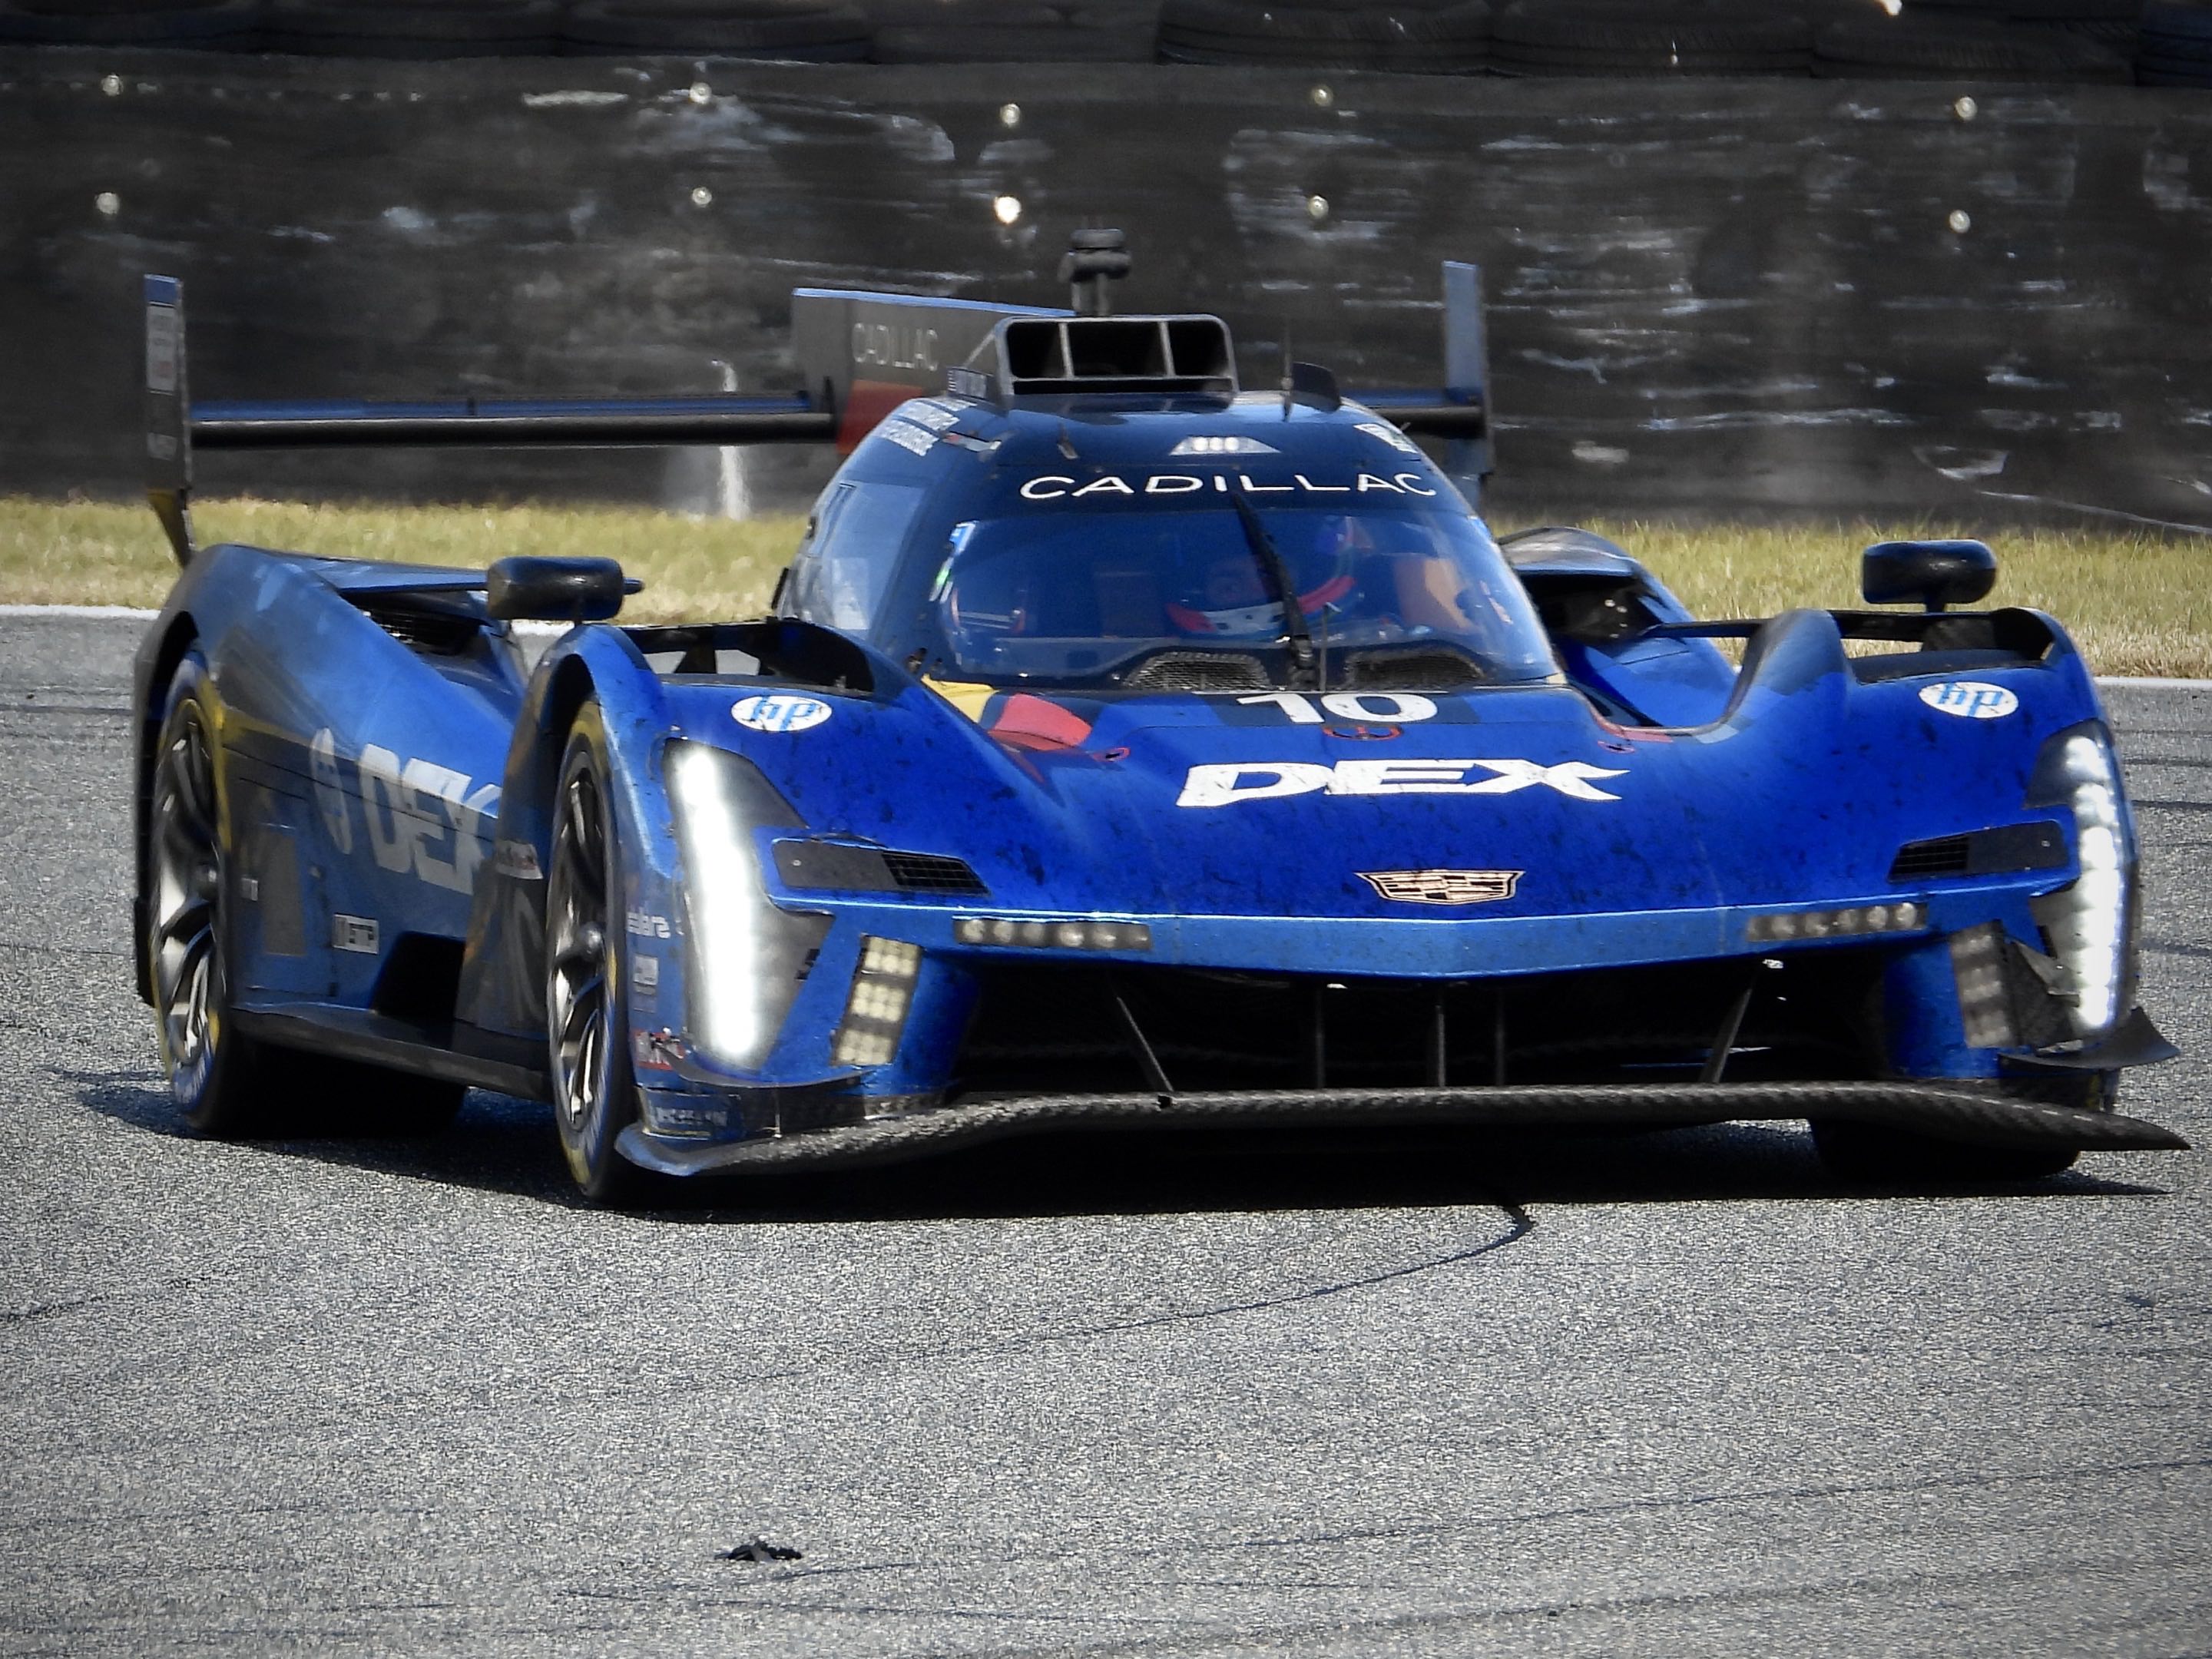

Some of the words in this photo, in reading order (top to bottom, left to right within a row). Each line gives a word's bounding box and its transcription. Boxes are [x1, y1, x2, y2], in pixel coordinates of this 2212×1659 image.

[1020, 472, 1436, 500] CADILLAC
[748, 696, 819, 732] hp
[1237, 692, 1438, 724] 10
[1937, 682, 2004, 717] hp
[1177, 759, 1631, 807] DEX
